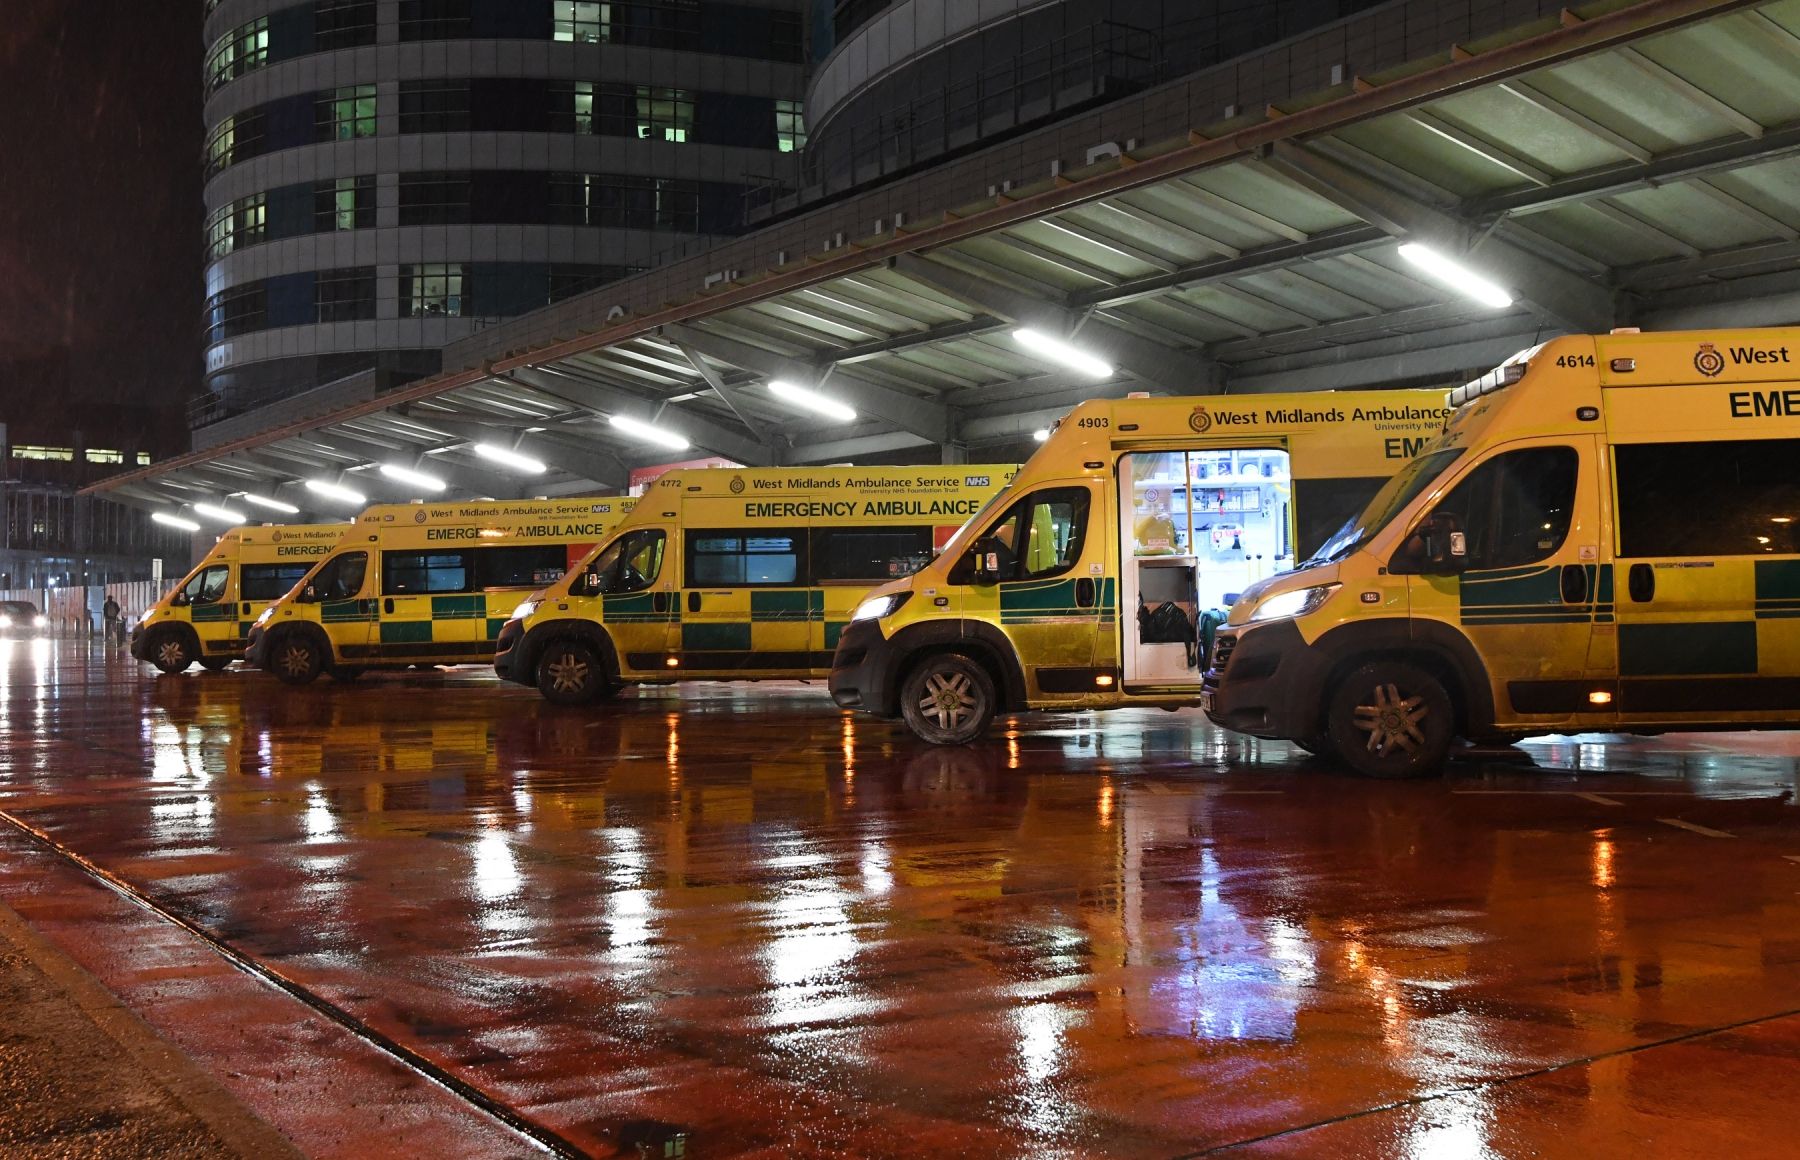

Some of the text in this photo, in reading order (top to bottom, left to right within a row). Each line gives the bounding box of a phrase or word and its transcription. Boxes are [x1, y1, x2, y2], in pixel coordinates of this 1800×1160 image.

[1556, 355, 1595, 368] 4614
[1729, 347, 1790, 364] West
[1729, 390, 1800, 417] EME
[1214, 405, 1451, 425] West Midlands Ambulance
[1078, 417, 1109, 428] 4903
[1374, 422, 1421, 432] University
[1385, 437, 1431, 459] EM
[660, 479, 682, 488] 4772
[753, 476, 990, 489] West Midlands Ambulance Service NHS
[431, 504, 611, 518] West Midlands Ambulance Service NHS
[745, 500, 980, 518] EMERGENCY AMBULANCE
[283, 531, 301, 539] West
[303, 531, 336, 539] Midlands
[426, 523, 603, 540] EMERGEY AMBULANCE
